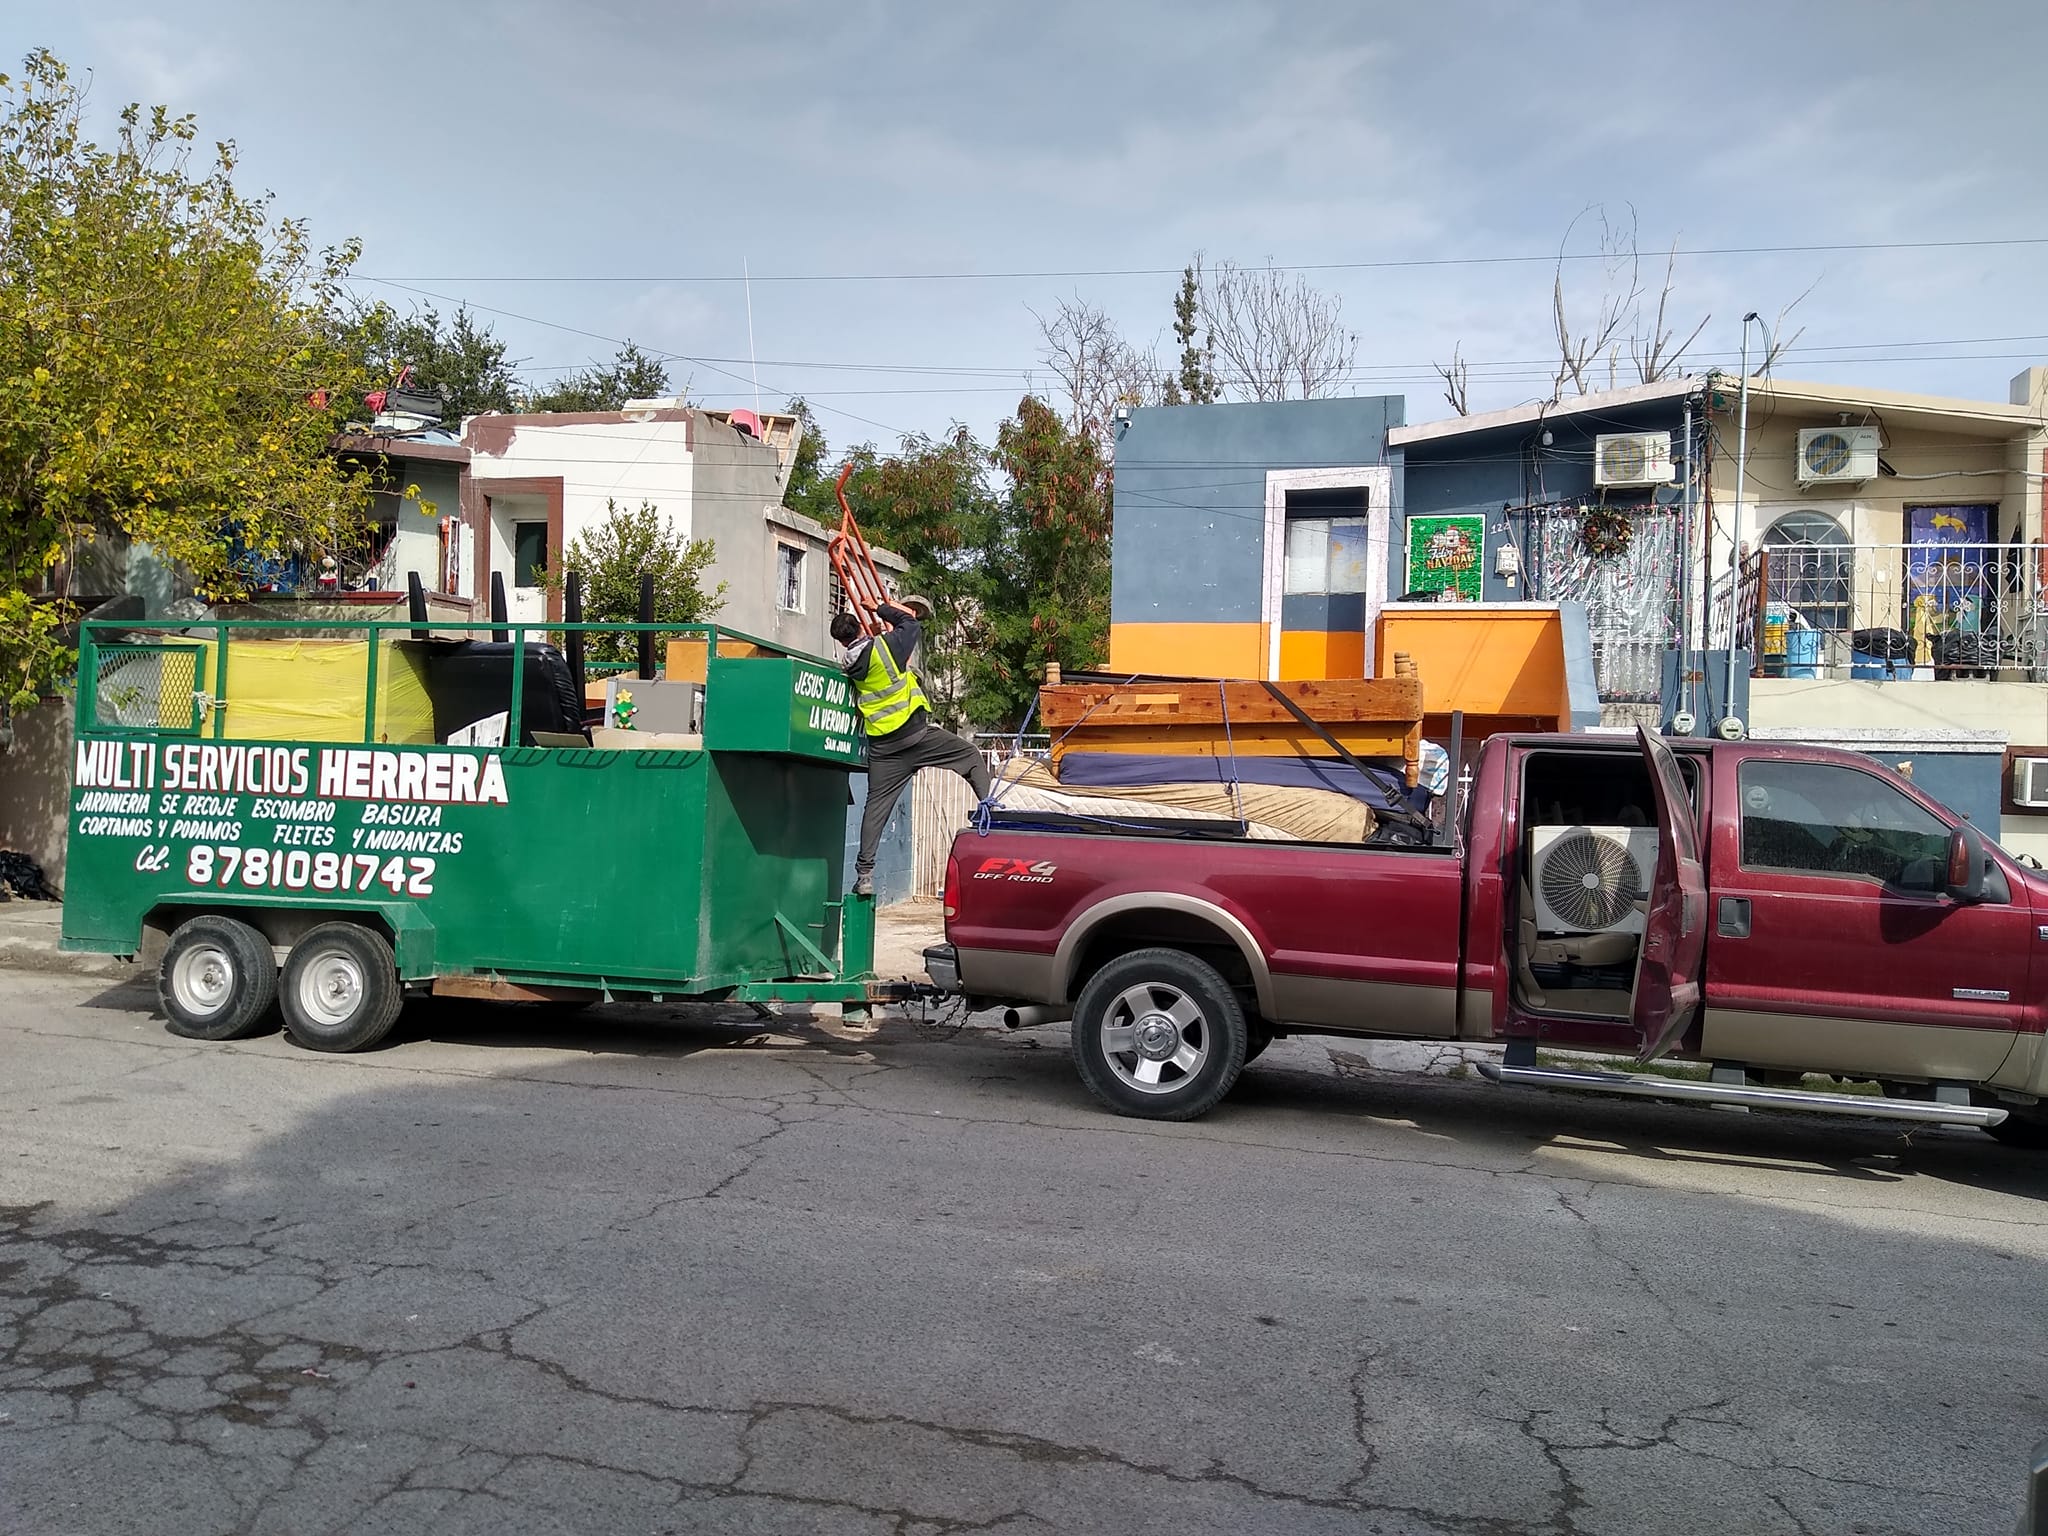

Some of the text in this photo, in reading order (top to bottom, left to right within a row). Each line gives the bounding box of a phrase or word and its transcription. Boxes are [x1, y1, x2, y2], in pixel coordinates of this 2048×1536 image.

[1426, 553, 1475, 569] NAVIDAD
[794, 671, 825, 699] JESUS
[826, 678, 846, 706] DIJO
[809, 705, 820, 730] LA
[820, 708, 850, 736] VERDAD
[850, 715, 859, 736] Y
[824, 737, 836, 752] SAN
[837, 740, 851, 754] JUAN
[75, 740, 509, 804] MULTI SERVICIOS HERRERA
[75, 792, 443, 828] JARDINERIA SE RECOJE ESCOMBRO BASURA
[79, 816, 464, 855] CORTAMOS Y PODAMOS FLETES Y MUDANZAS
[135, 844, 436, 897] Cel. 8781081742
[973, 872, 1054, 884] OFF ROAD
[977, 858, 1058, 876] FX4
